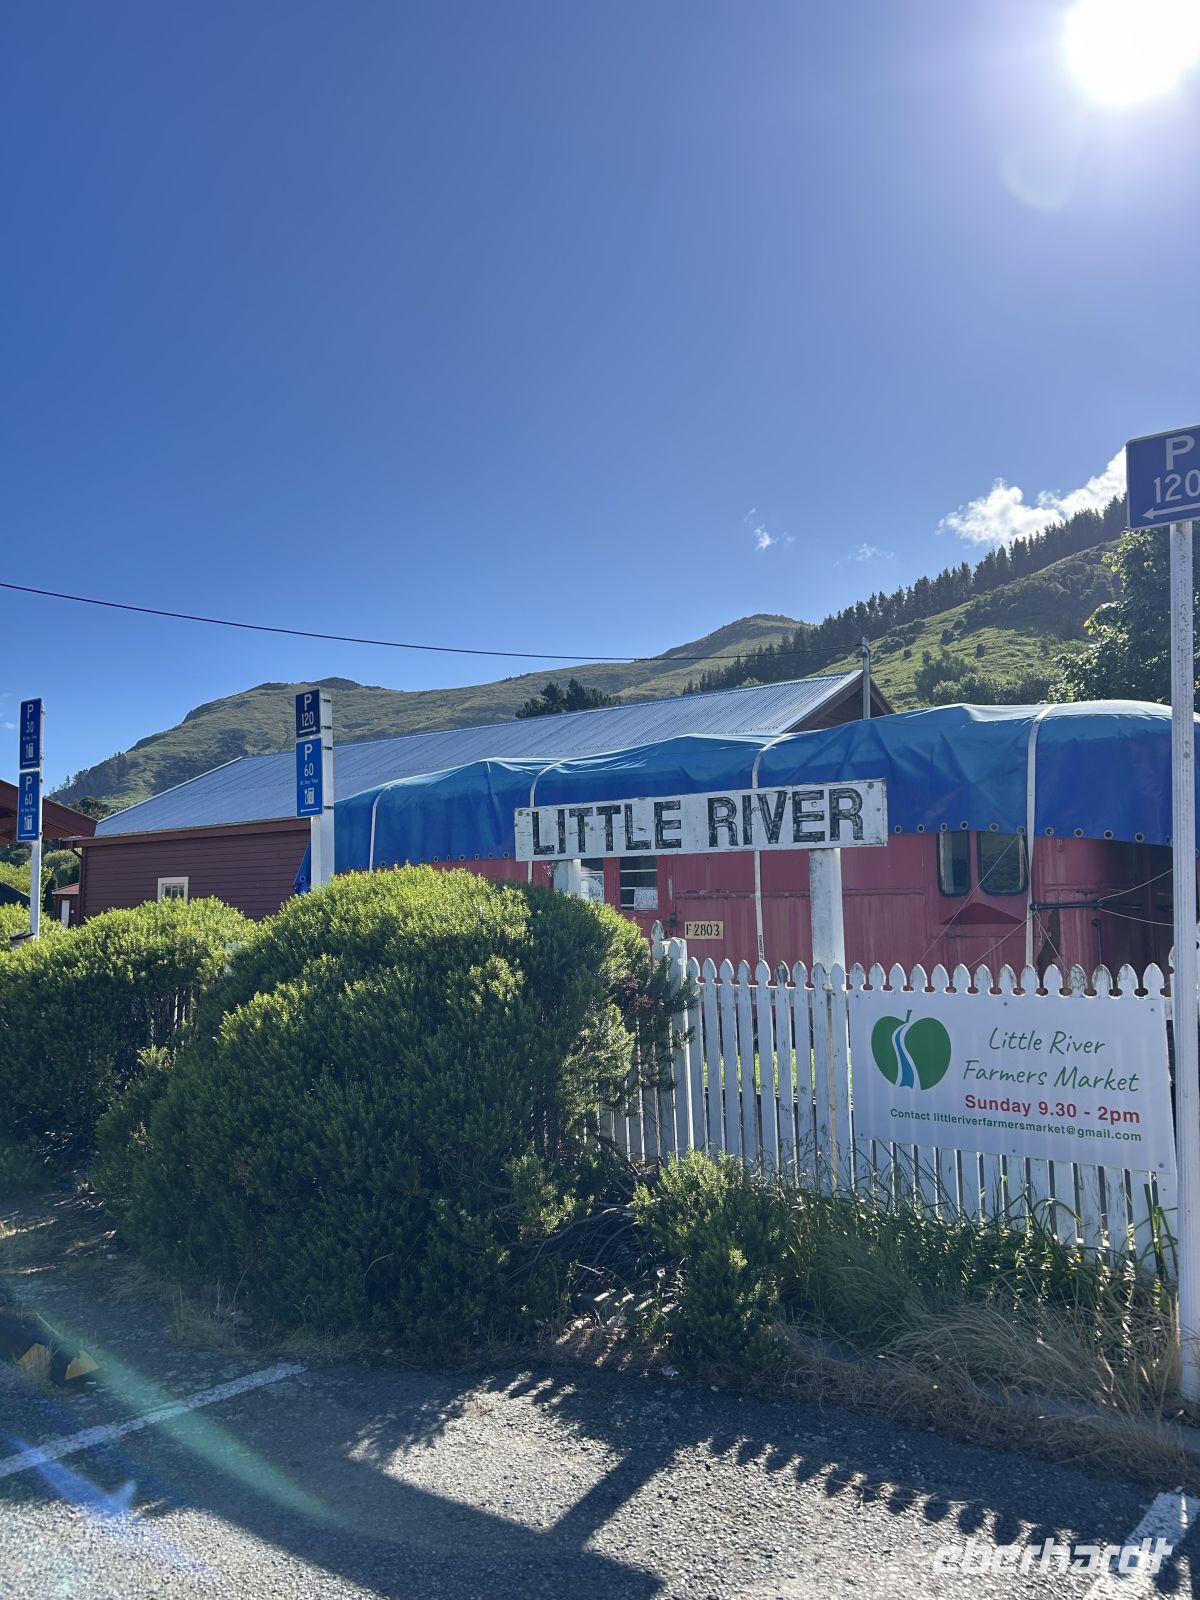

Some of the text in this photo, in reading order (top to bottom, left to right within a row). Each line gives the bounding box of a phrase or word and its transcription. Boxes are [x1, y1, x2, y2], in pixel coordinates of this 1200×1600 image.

[1165, 434, 1195, 470] P
[1153, 469, 1200, 503] 120
[27, 703, 34, 719] P
[304, 693, 313, 711] P
[302, 711, 314, 728] 120
[304, 743, 313, 761] P
[304, 762, 314, 777] 60
[25, 775, 33, 791] P
[24, 793, 33, 806] 60
[531, 788, 864, 855] LITTLE RIVER
[989, 1027, 1105, 1055] Little River
[963, 1060, 1139, 1092] Farmers Market
[965, 1094, 1031, 1117] Sunday
[1038, 1101, 1077, 1118] 9.30
[1097, 1105, 1140, 1125] 2pm
[890, 1108, 1142, 1142] Contact littleriverfarmersmarket@gmail.com
